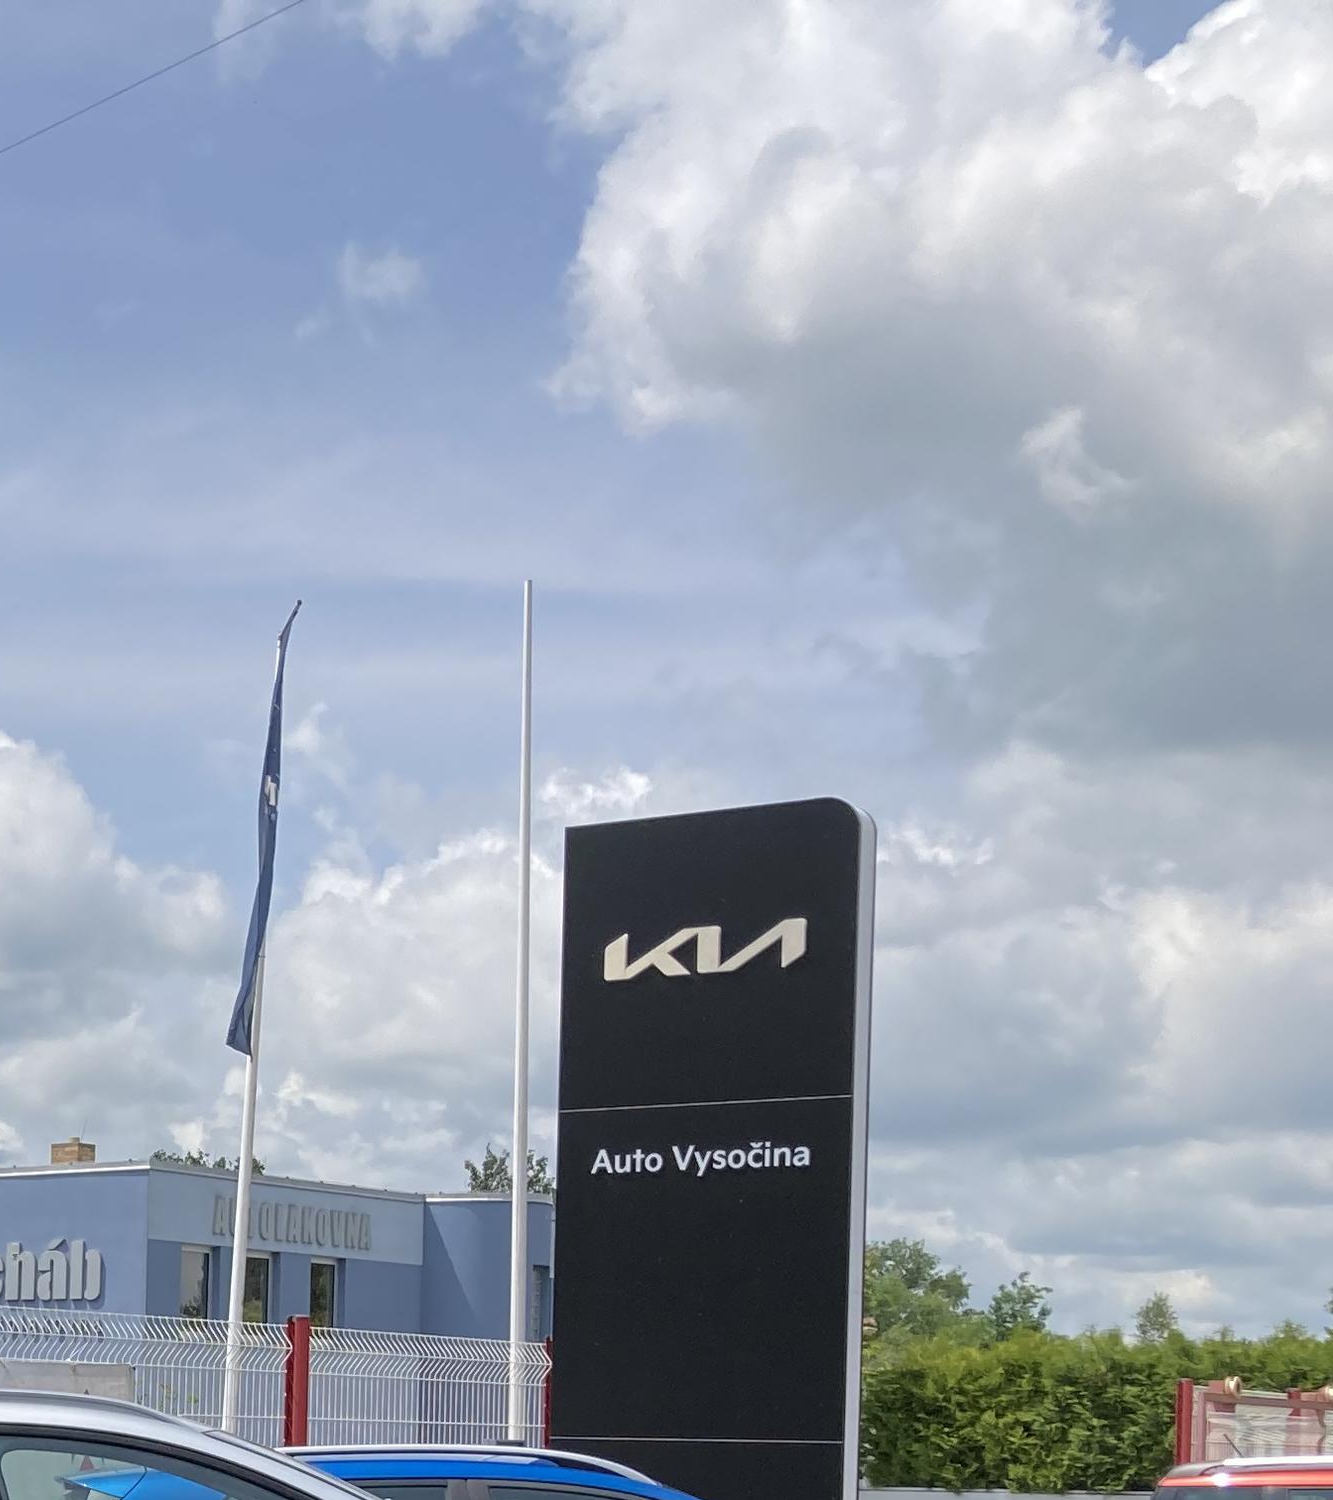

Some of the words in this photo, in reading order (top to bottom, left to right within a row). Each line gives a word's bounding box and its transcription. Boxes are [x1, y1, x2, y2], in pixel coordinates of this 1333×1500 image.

[603, 917, 808, 982] KIA
[590, 1148, 664, 1175] Auto
[671, 1141, 811, 1177] Vysočina
